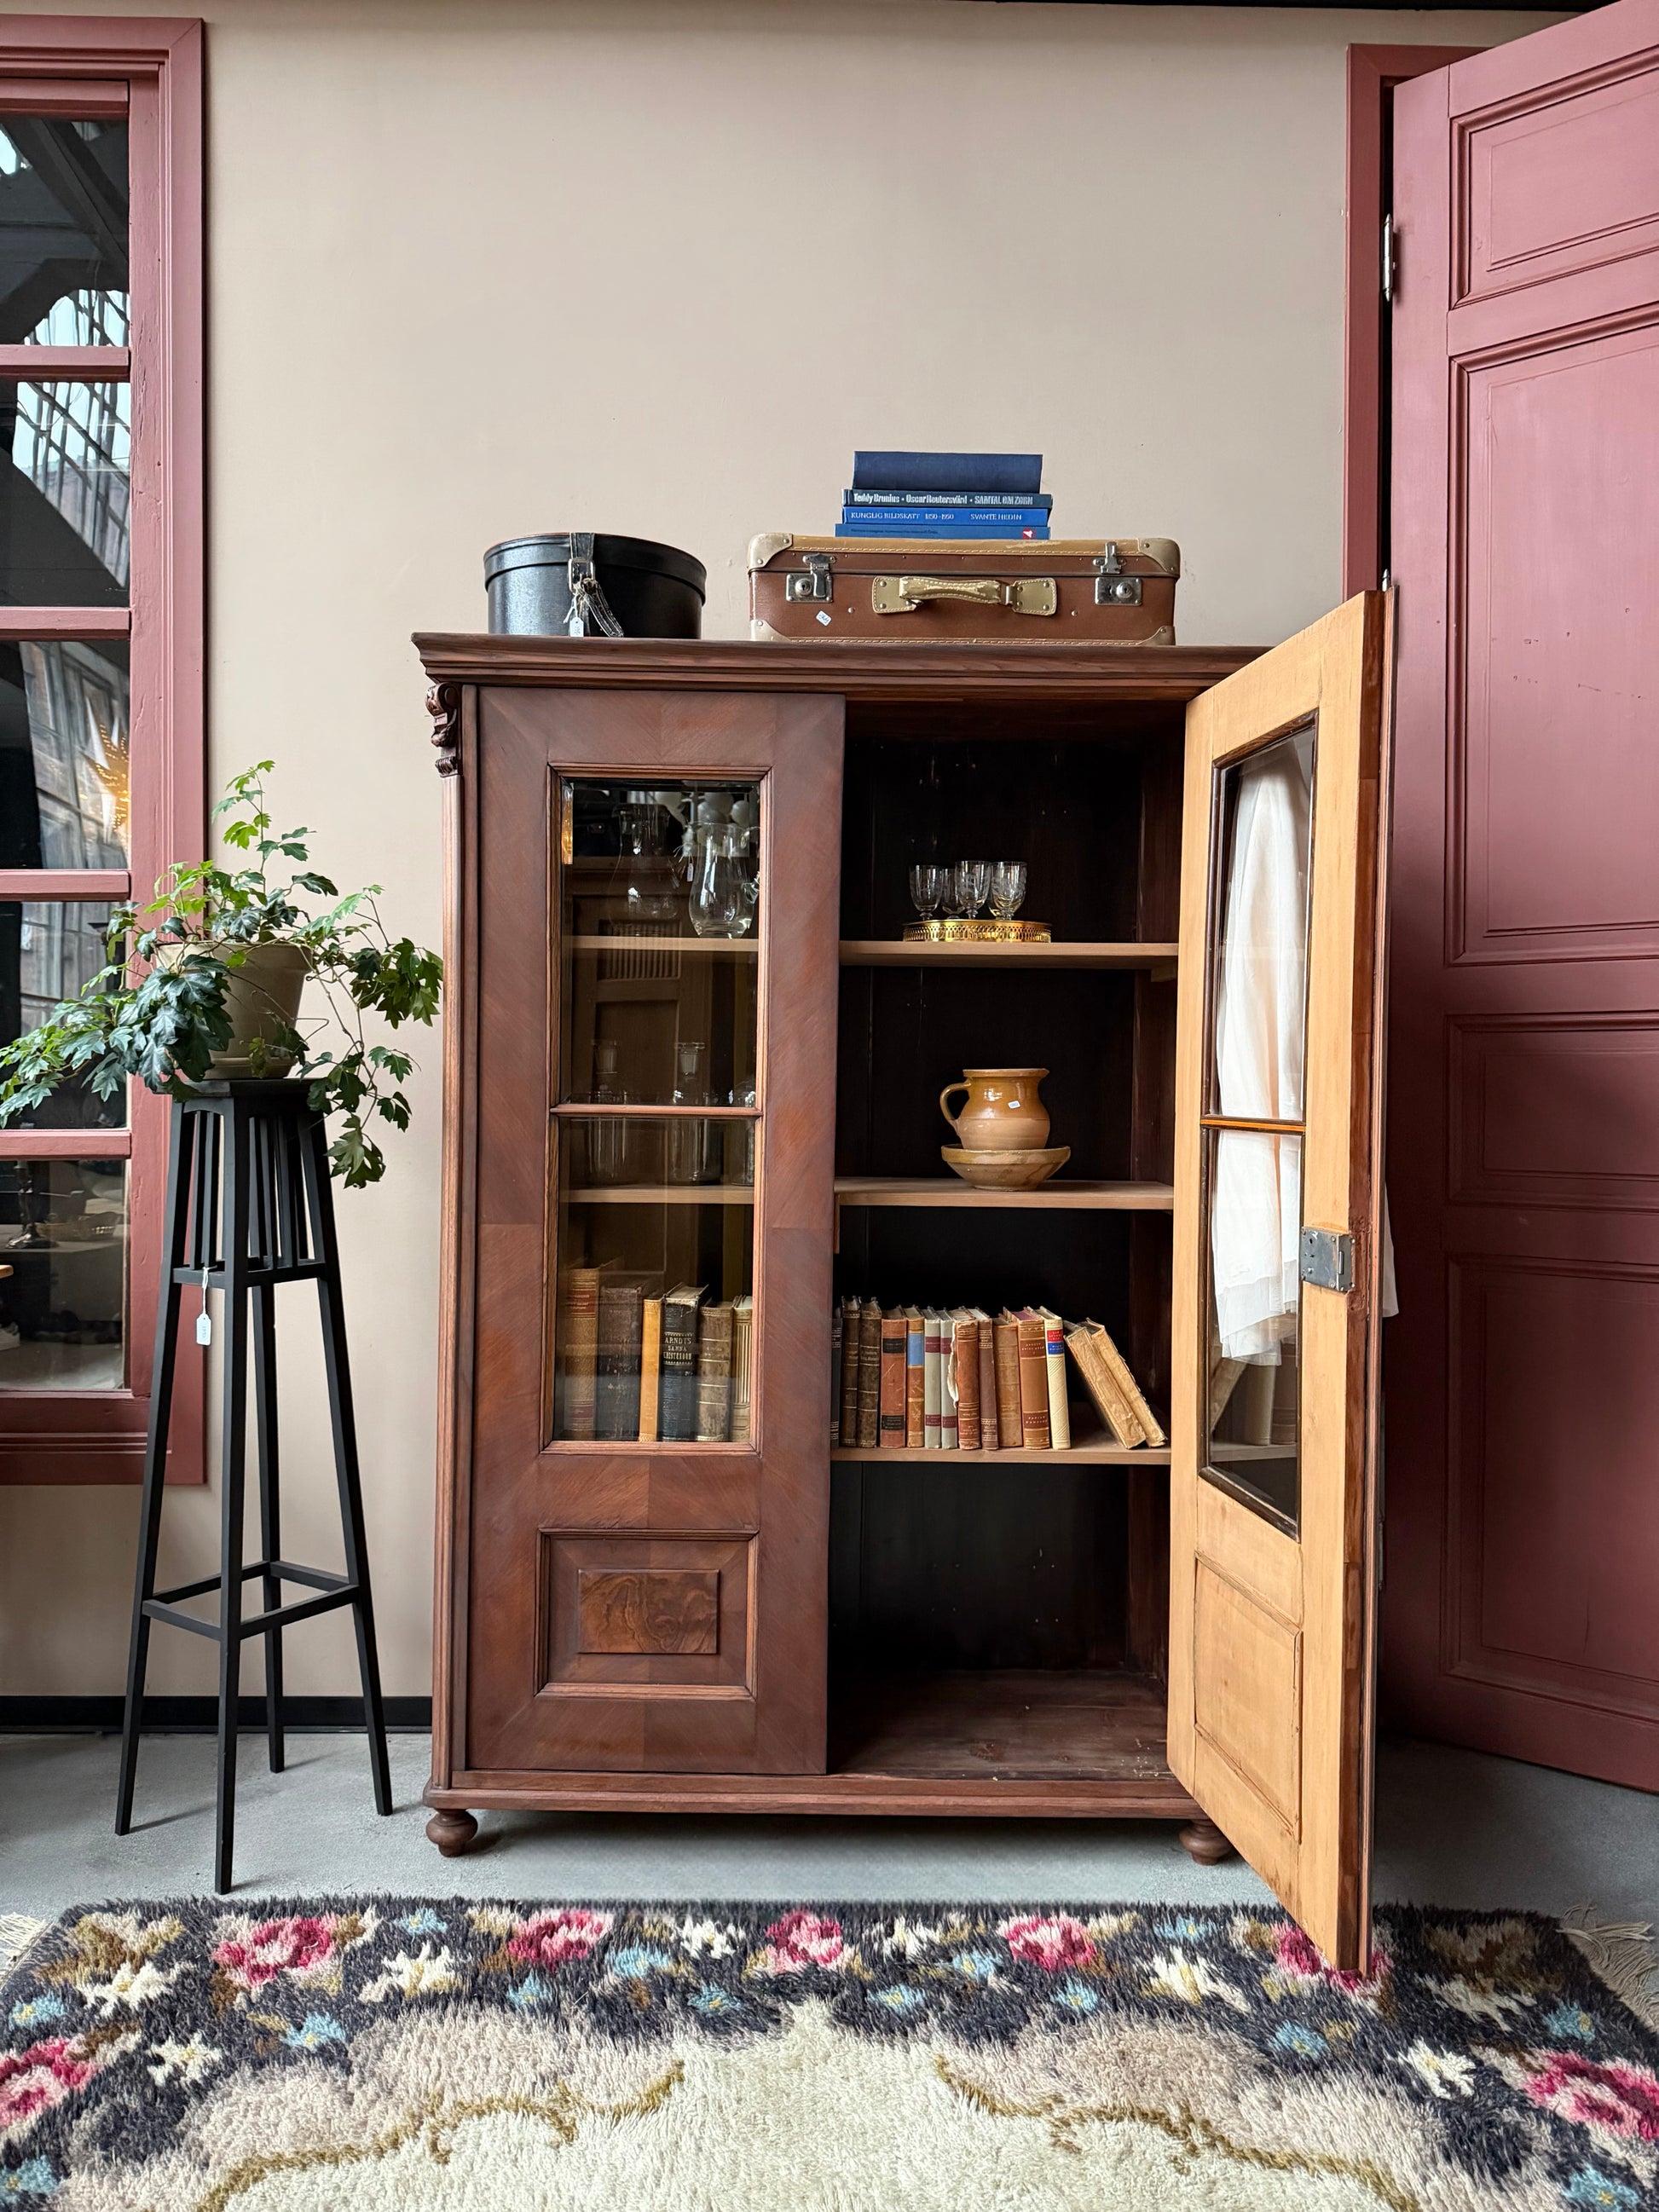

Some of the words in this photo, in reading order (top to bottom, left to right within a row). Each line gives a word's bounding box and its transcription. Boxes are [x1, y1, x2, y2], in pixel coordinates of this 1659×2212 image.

[853, 493, 873, 504] Teddy
[874, 494, 900, 503] Brunius
[905, 494, 926, 504] Oscar
[974, 495, 1002, 505] SAMTAL
[1014, 496, 1033, 505] ZORN
